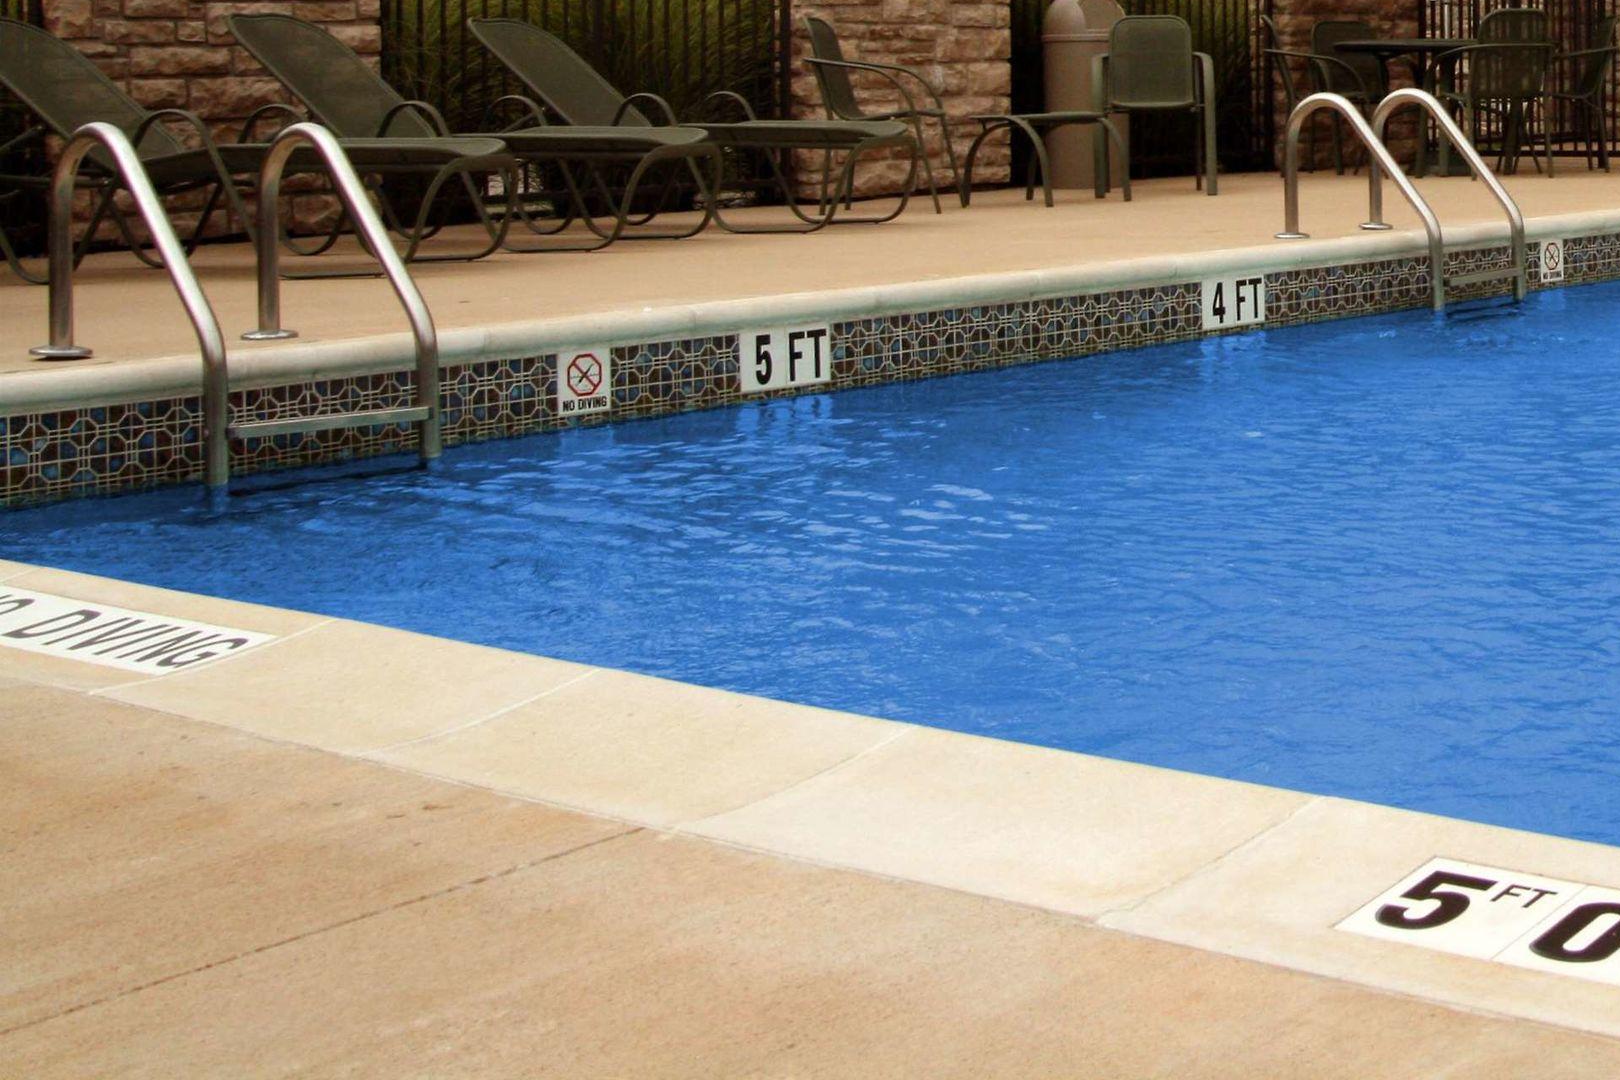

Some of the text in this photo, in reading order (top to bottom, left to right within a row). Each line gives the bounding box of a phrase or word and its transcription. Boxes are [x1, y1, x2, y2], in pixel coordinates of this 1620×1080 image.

[1212, 277, 1263, 324] 4 FT
[755, 328, 827, 386] 5 FT
[562, 395, 607, 413] NO DIVING
[1, 608, 249, 668] DIVING
[1374, 869, 1499, 931] 5
[1490, 883, 1559, 909] FT
